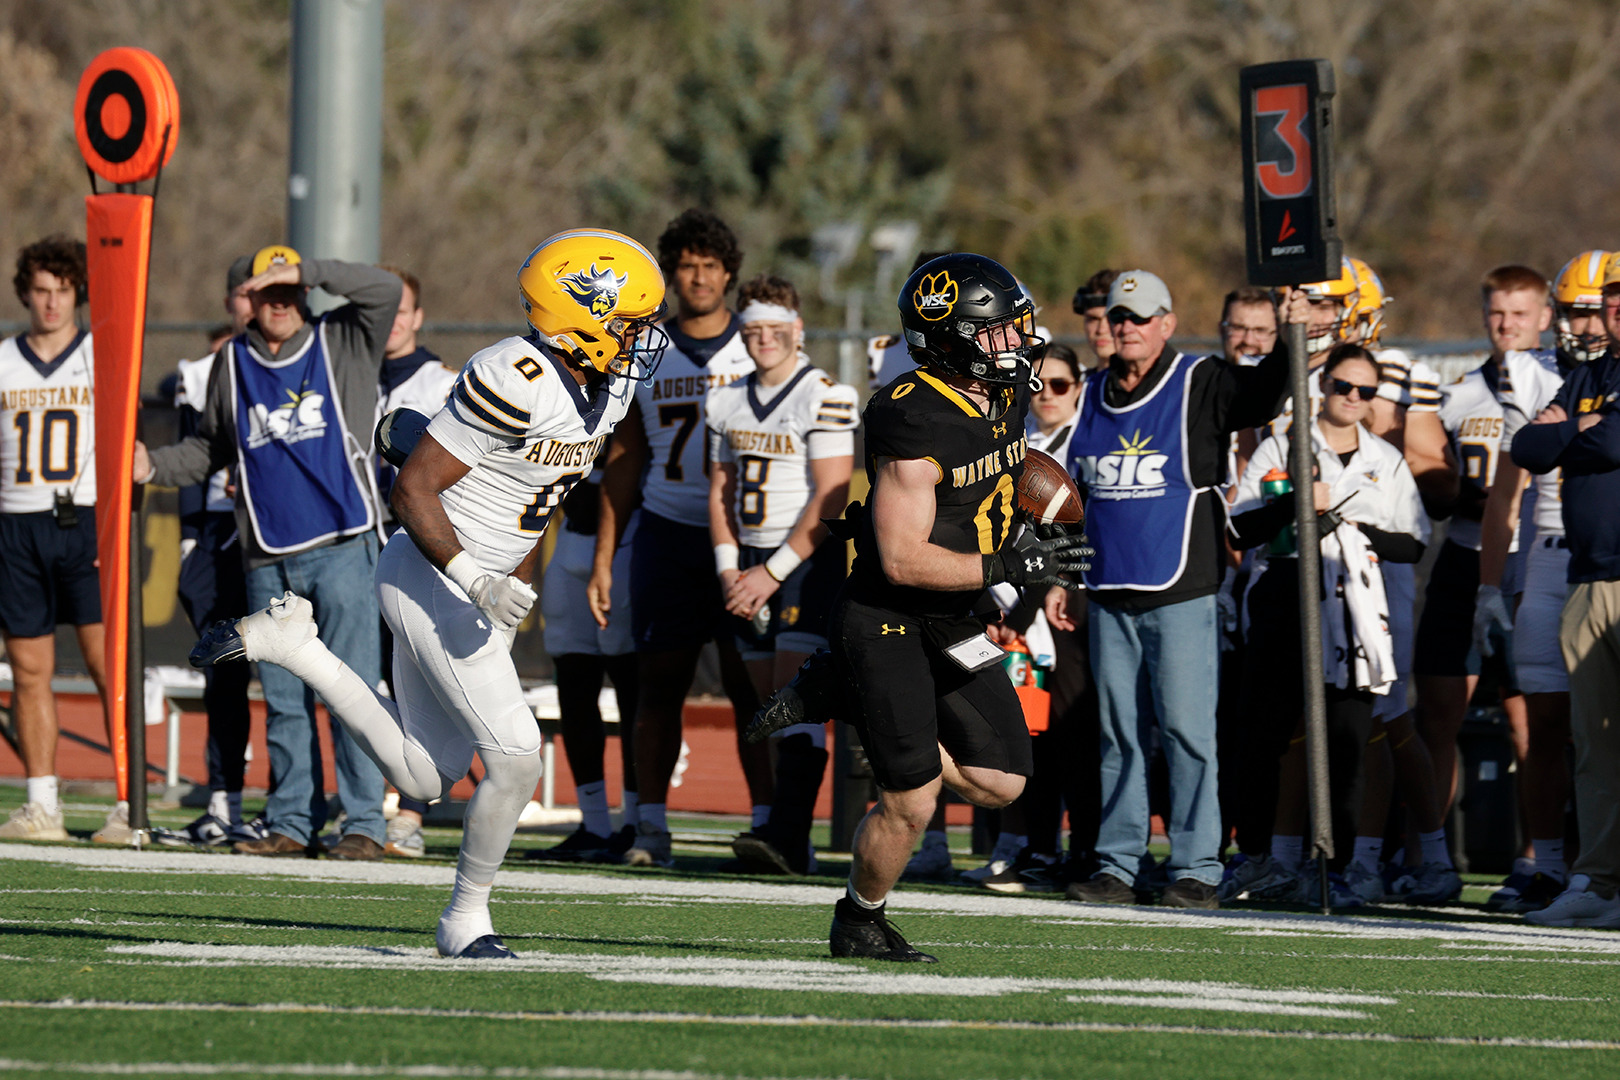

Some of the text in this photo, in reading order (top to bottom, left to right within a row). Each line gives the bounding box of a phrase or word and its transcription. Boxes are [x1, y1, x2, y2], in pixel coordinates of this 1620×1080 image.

[1256, 84, 1312, 199] 3
[922, 293, 950, 306] WSC
[1, 386, 91, 410] AUGUSTANA
[512, 356, 544, 383] 0
[891, 382, 916, 400] 0
[13, 408, 79, 485] 10
[952, 428, 1028, 488] WAYNE STA
[741, 455, 772, 527] 8
[973, 473, 1014, 555] 0
